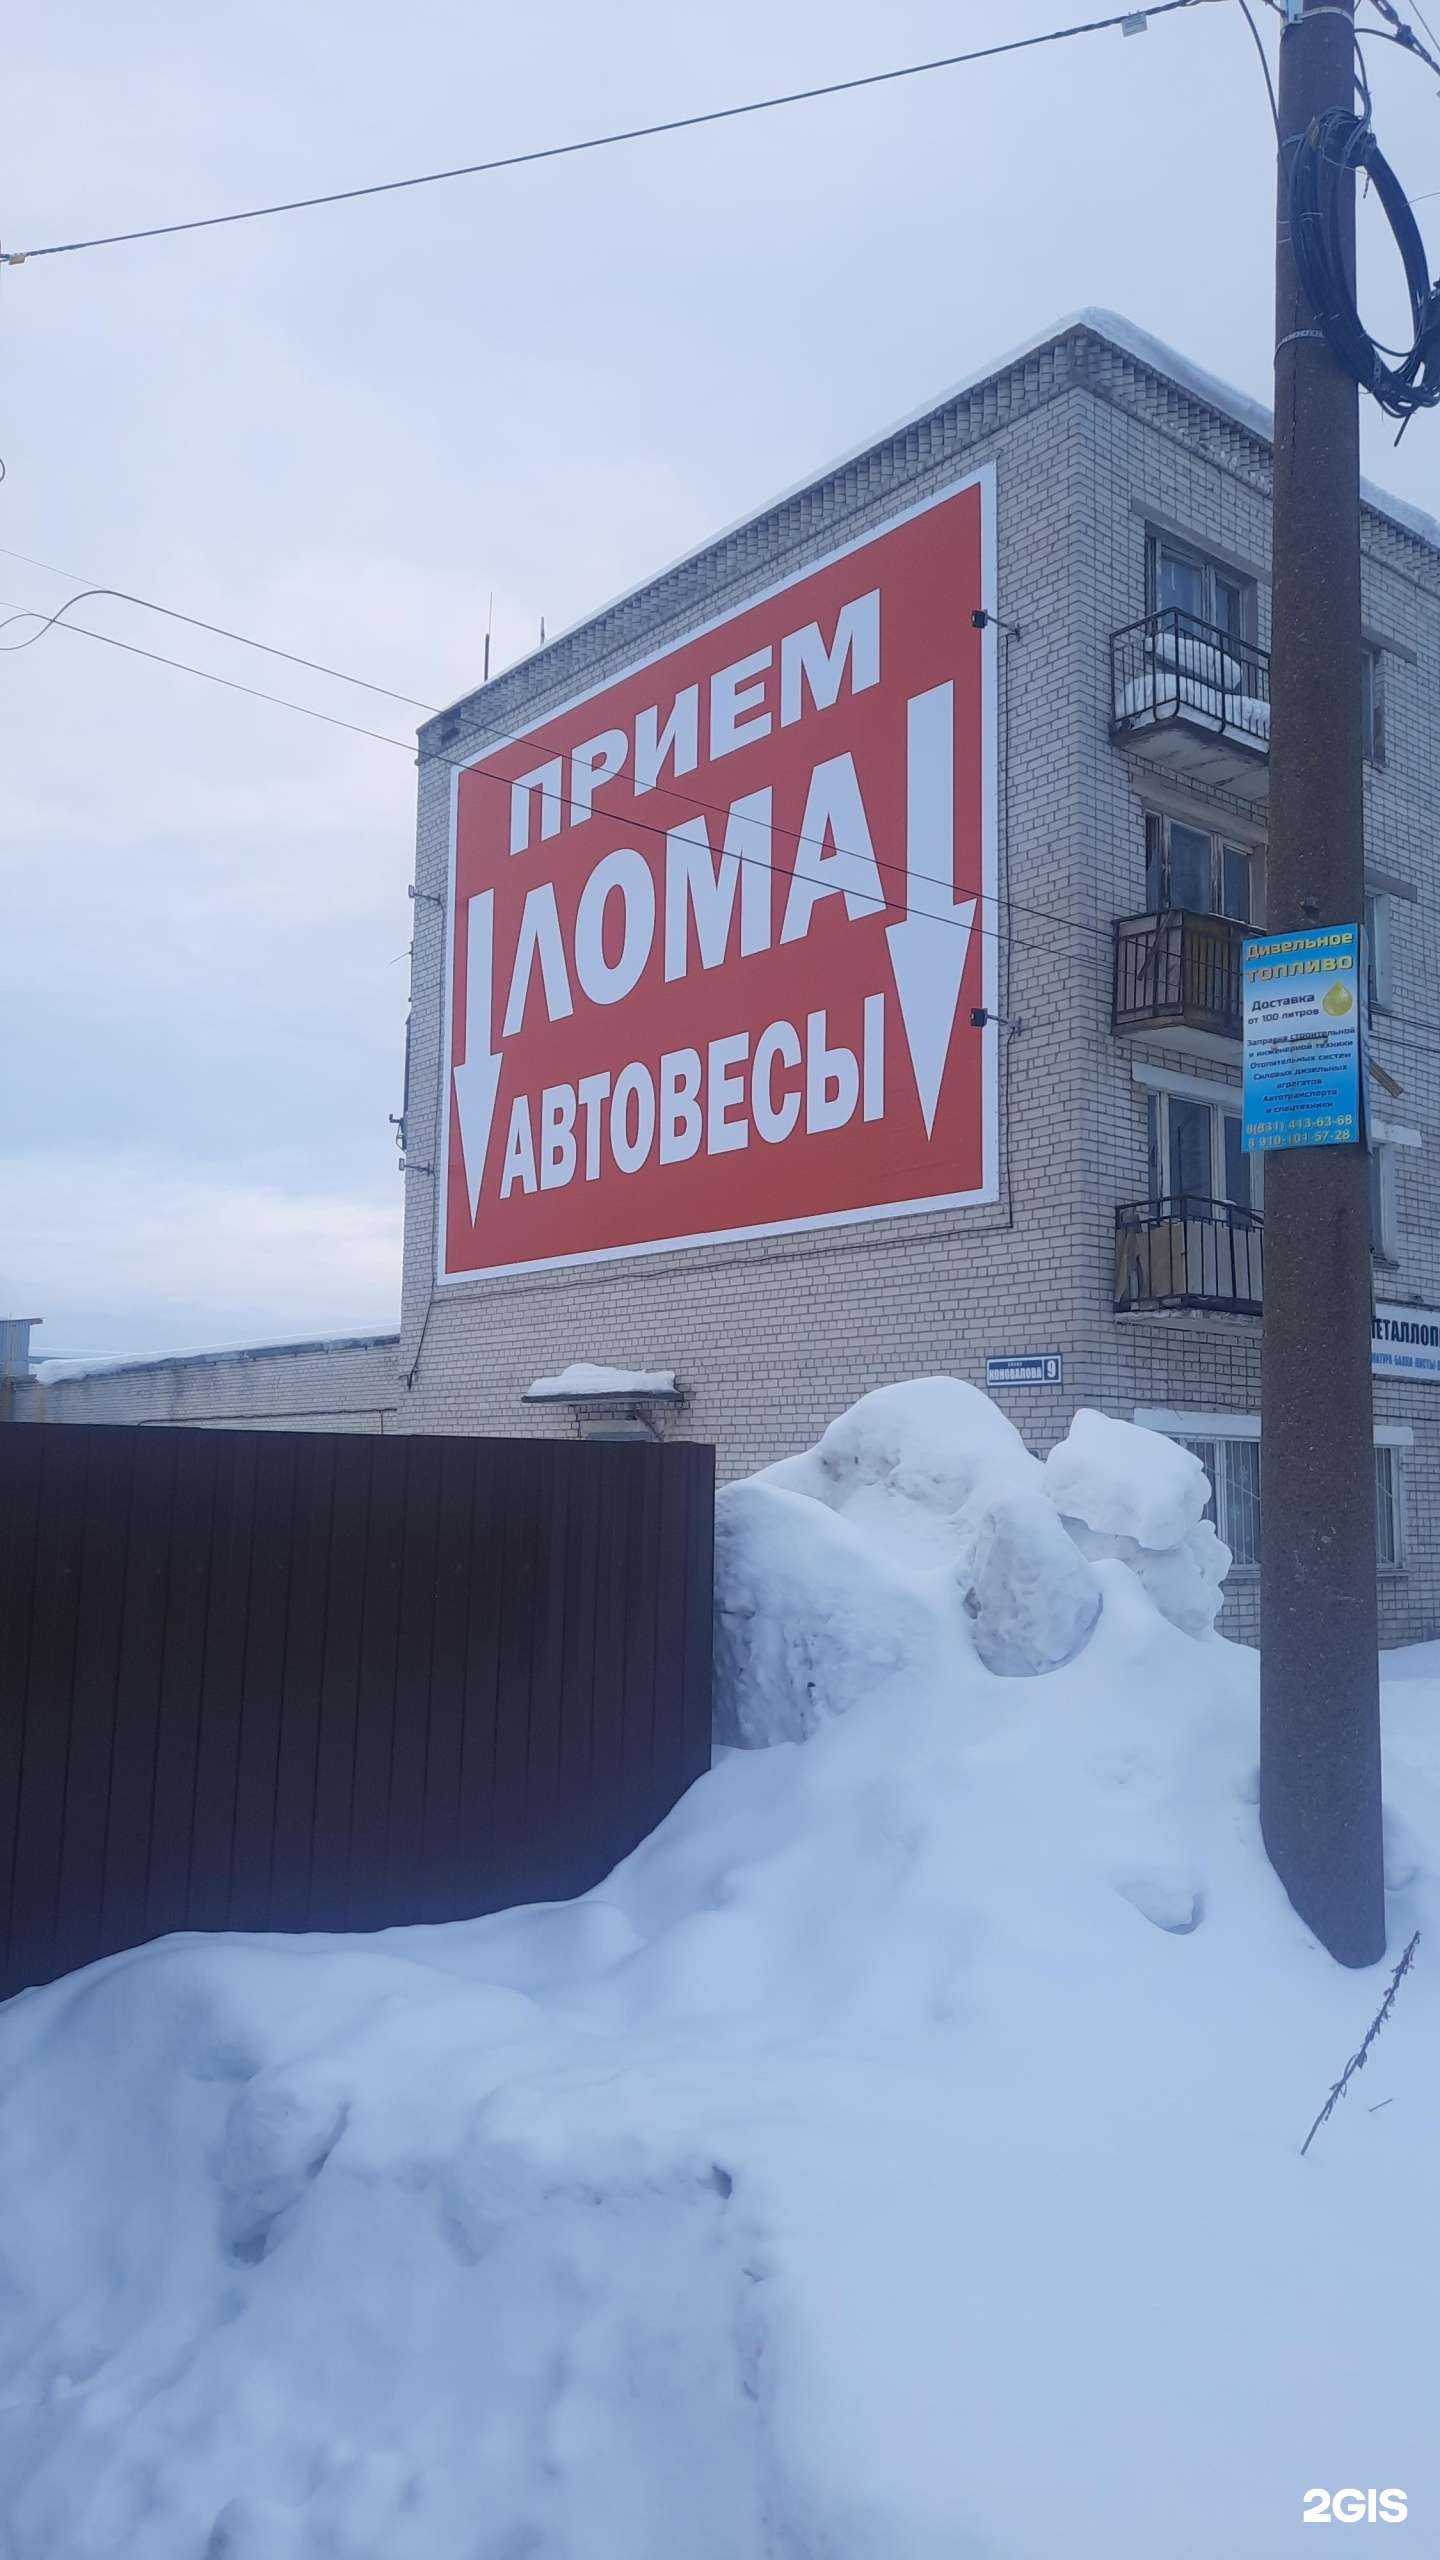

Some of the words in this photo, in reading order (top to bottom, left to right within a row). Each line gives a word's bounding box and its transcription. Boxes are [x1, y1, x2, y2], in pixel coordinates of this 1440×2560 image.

[509, 588, 881, 856] ПРИЕМ
[502, 751, 887, 1039] ЛОМА
[1248, 933, 1353, 960] Дизельное
[1248, 1017, 1258, 1025] от
[1262, 1013, 1279, 1022] 100
[1282, 1008, 1320, 1019] литров
[1252, 994, 1315, 1011] Доставка
[499, 992, 885, 1201] АВТОВЕСЫ
[1371, 1318, 1440, 1347] ЕТАЛЛОП
[1046, 1360, 1056, 1378] 9
